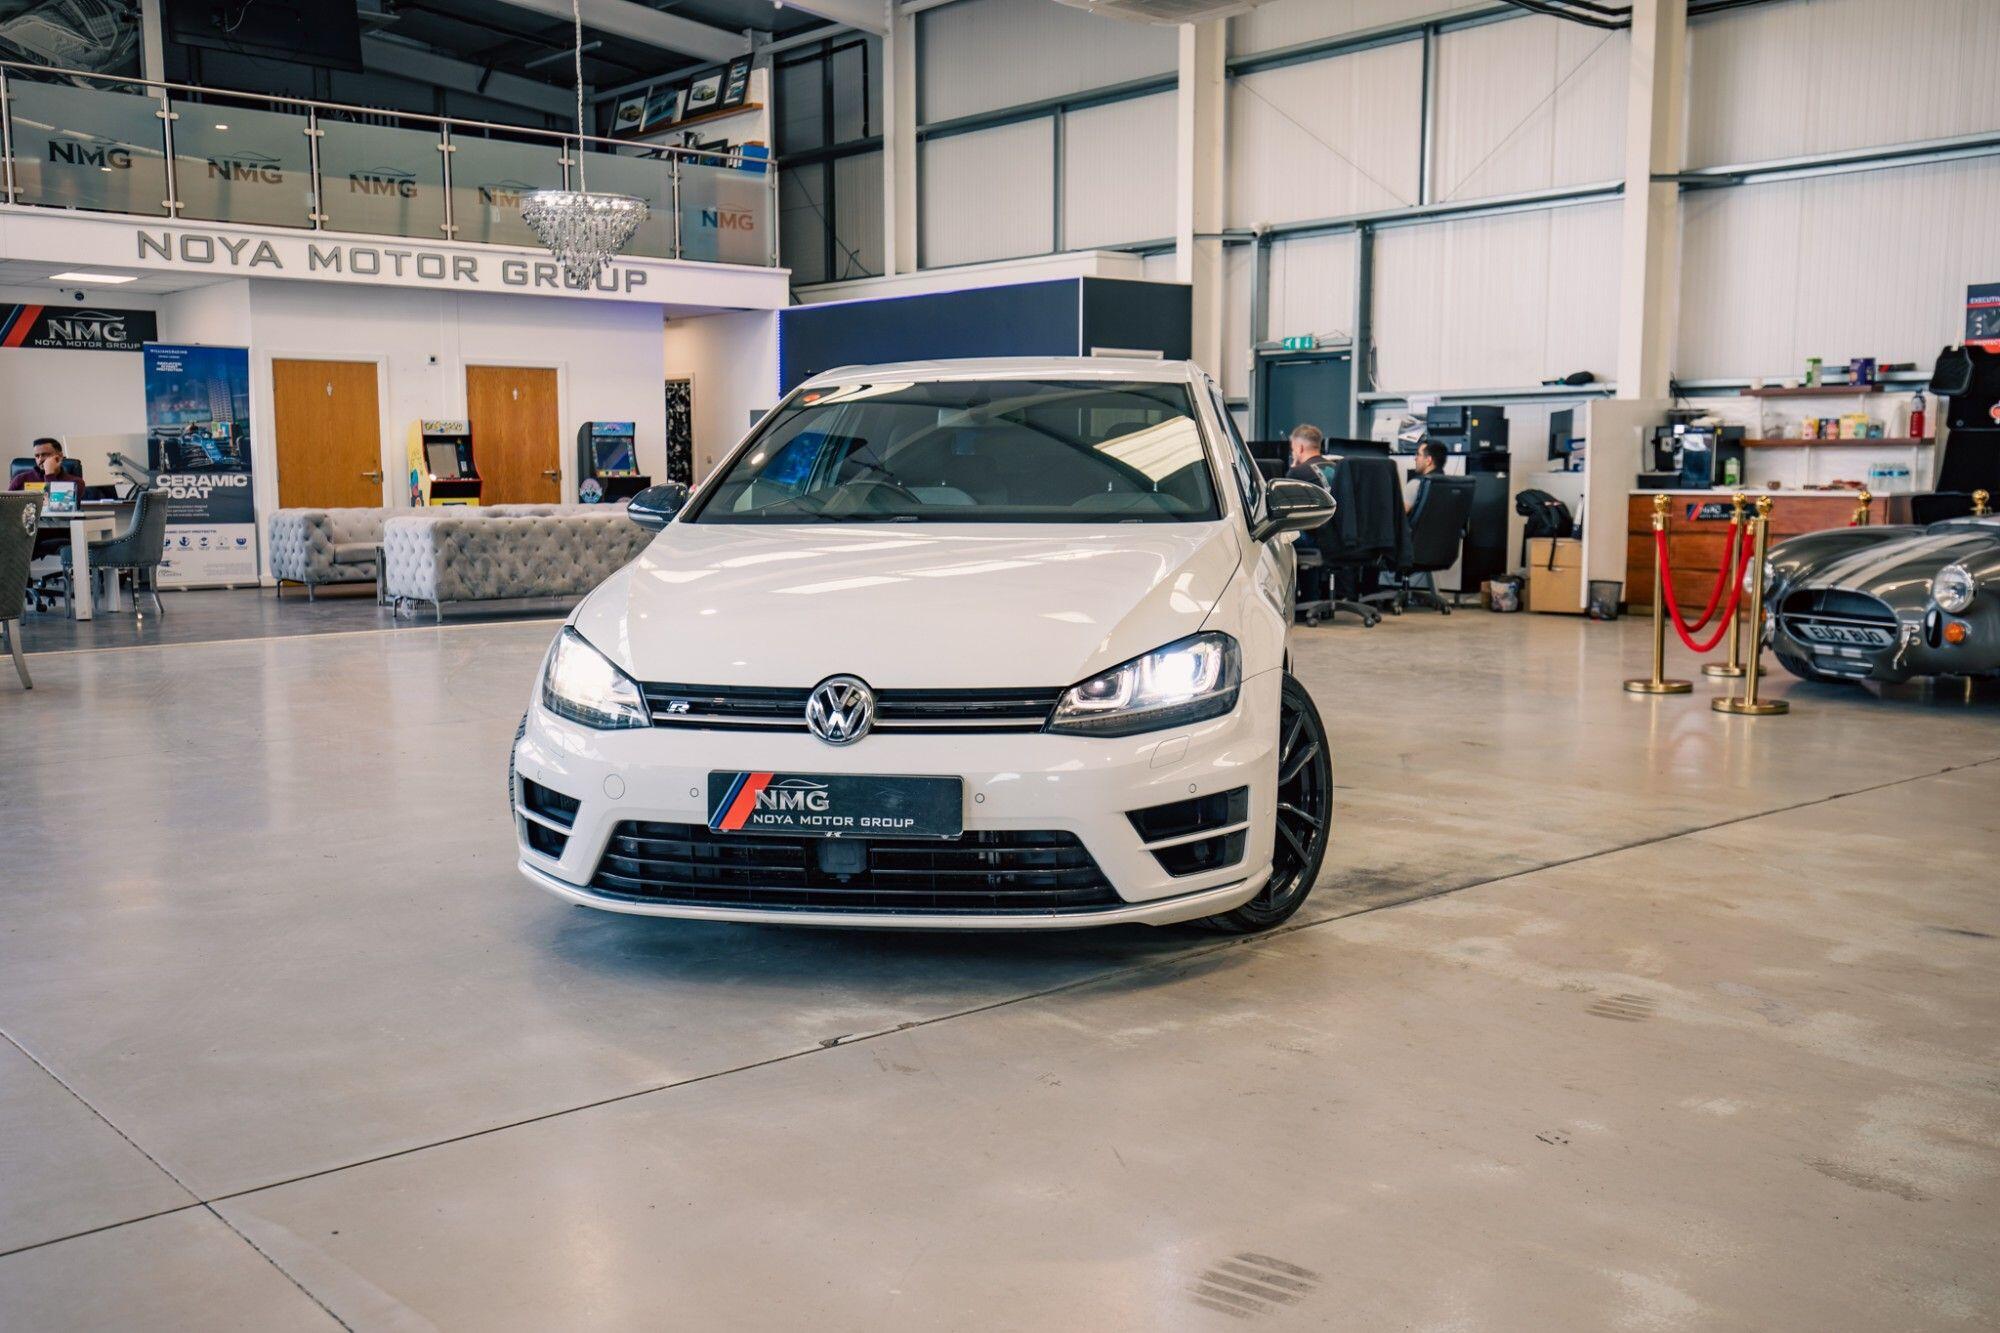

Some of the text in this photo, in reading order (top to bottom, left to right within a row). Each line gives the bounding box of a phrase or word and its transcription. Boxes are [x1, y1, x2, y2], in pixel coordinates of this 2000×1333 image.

[49, 140, 132, 169] NMG
[207, 157, 283, 185] NMG
[350, 174, 417, 198] NMG
[478, 186, 521, 208] NM
[702, 209, 754, 231] NMG
[137, 230, 283, 269] NOYA
[308, 243, 479, 282] MOTOR
[47, 319, 127, 342] NMG
[34, 338, 141, 350] NOYA MOTOR GROUP
[156, 474, 248, 487] CERAMIC
[667, 700, 691, 715] R
[810, 681, 871, 742] VW
[754, 788, 830, 812] NMG
[753, 814, 915, 828] NOYA MOTOR GROUP
